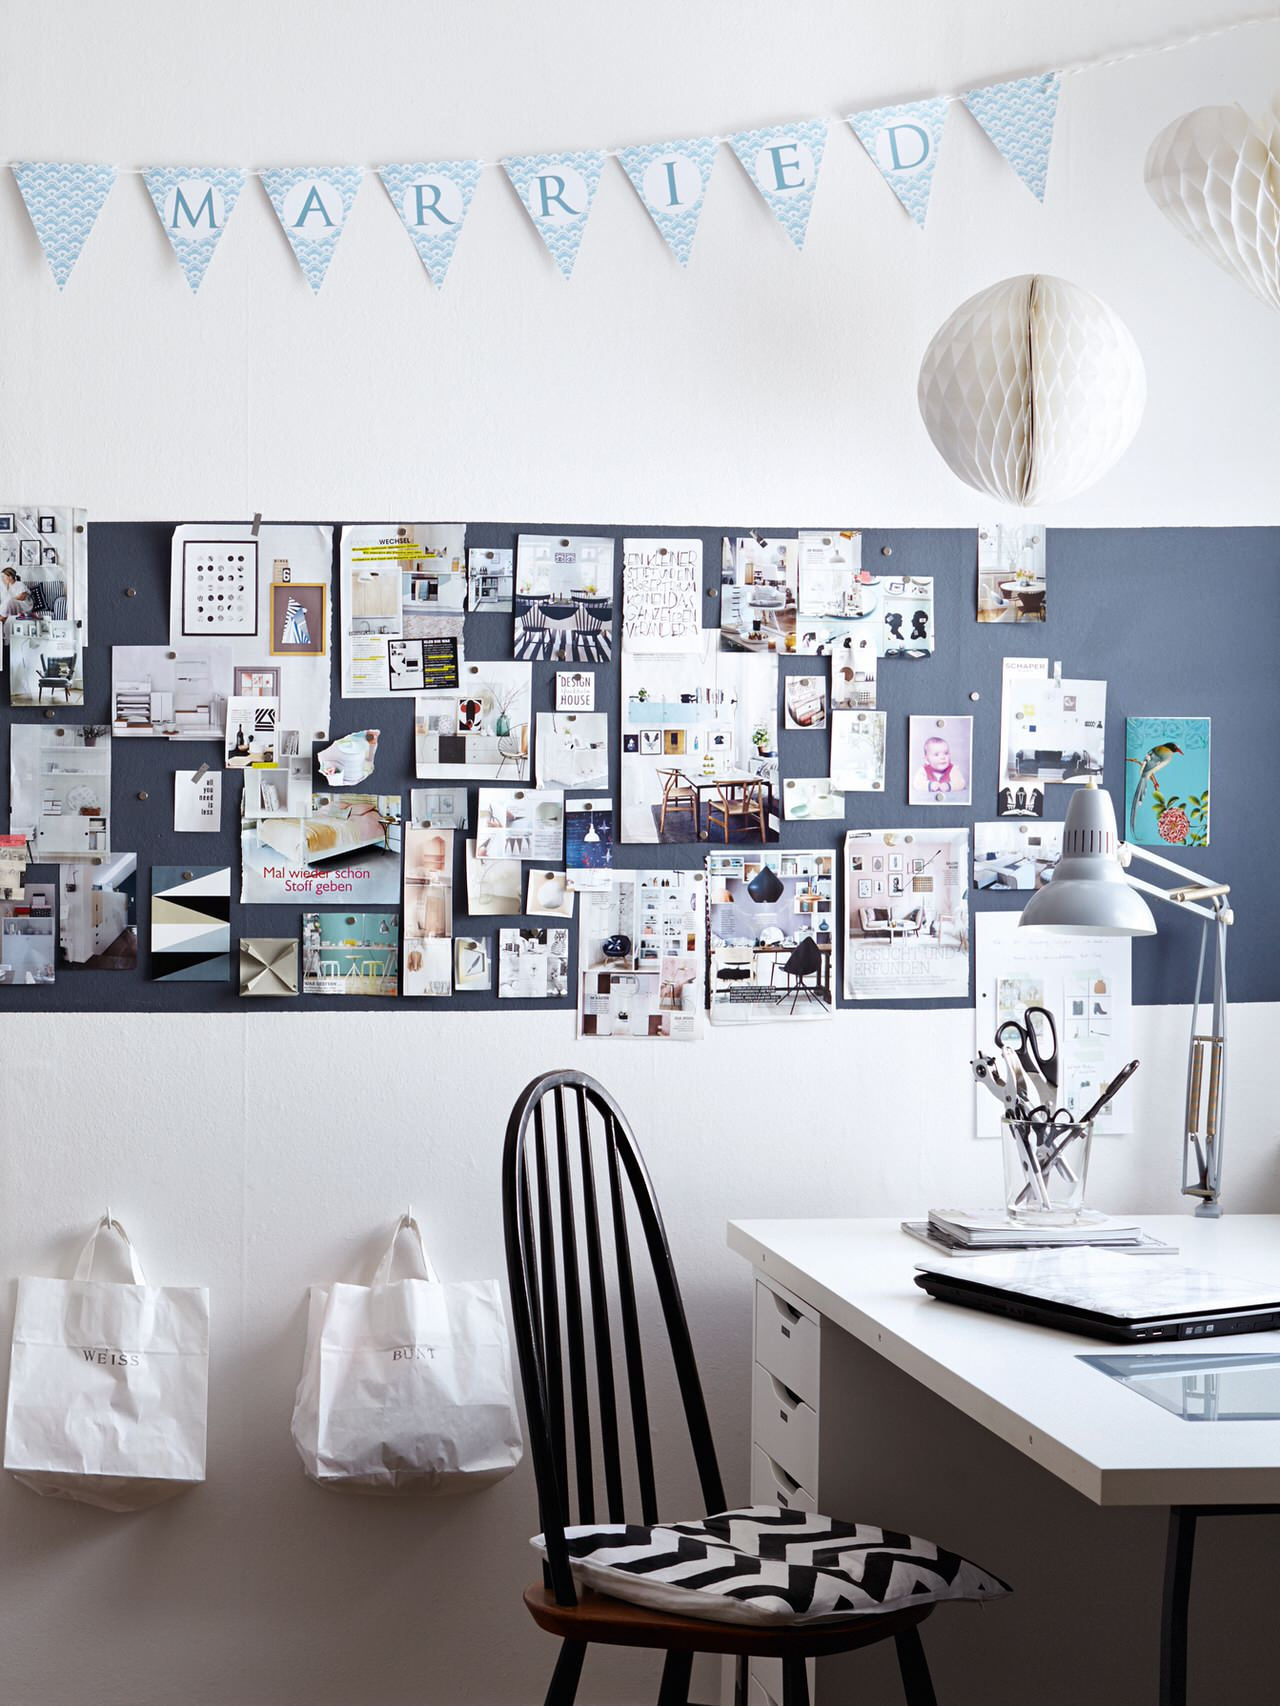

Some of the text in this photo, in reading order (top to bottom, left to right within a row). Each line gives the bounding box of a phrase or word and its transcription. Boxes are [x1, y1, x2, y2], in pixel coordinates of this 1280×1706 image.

[169, 124, 930, 229] MARRIED
[378, 537, 411, 545] WECHSEL
[561, 676, 591, 687] DESIGN
[561, 695, 591, 705] HOUSE
[263, 867, 285, 878] Mal
[288, 867, 330, 879] wieder
[285, 879, 353, 895] Stoff geben
[854, 960, 930, 975] ERFUNDEN
[83, 1350, 140, 1366] WEISS
[393, 1347, 435, 1361] BUNT
